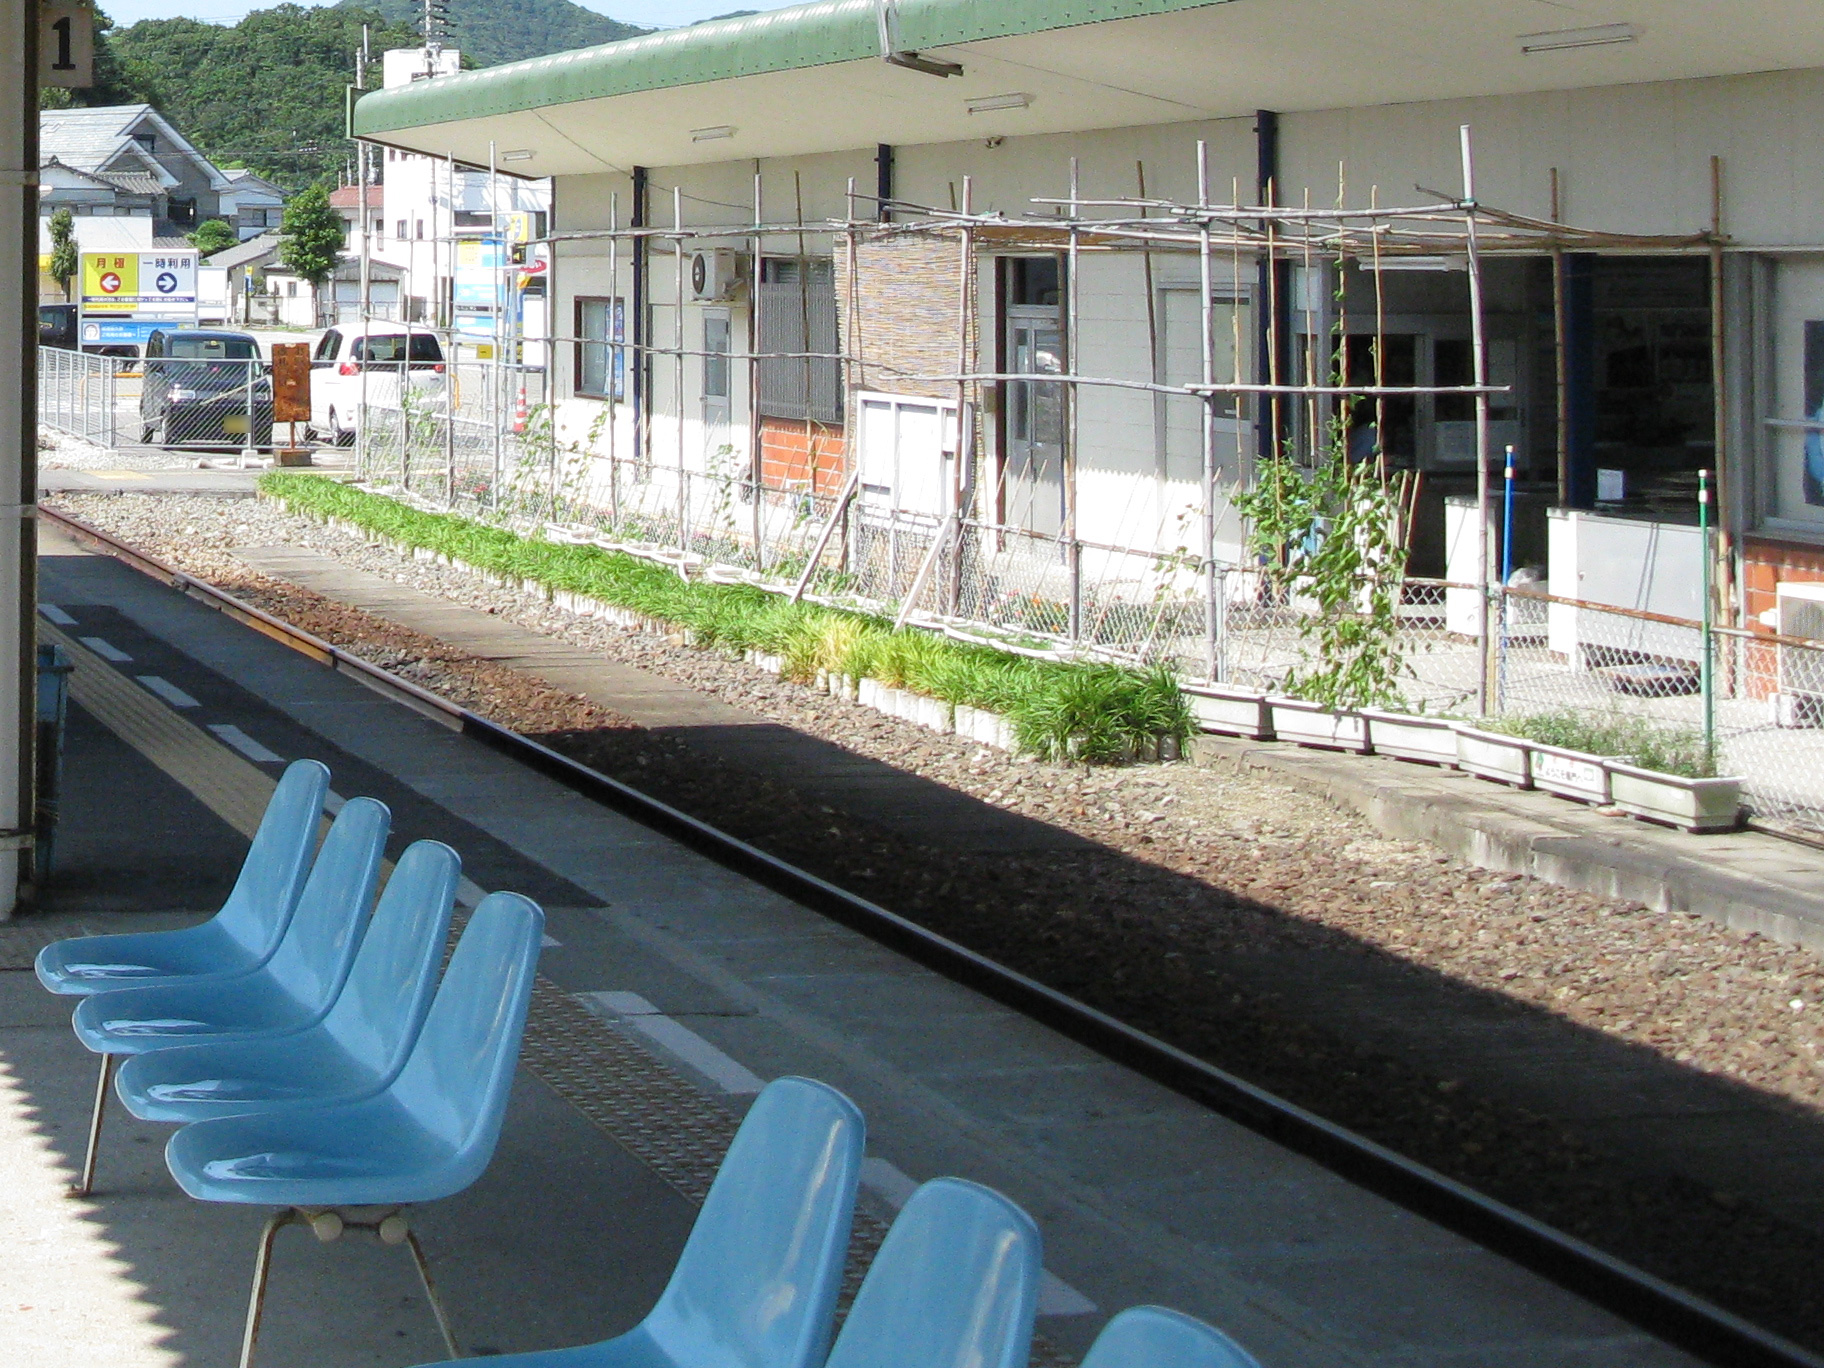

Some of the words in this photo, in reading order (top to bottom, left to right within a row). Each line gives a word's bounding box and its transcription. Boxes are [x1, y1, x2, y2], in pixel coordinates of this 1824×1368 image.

[51, 16, 76, 71] 1
[143, 257, 191, 270] 一時利用
